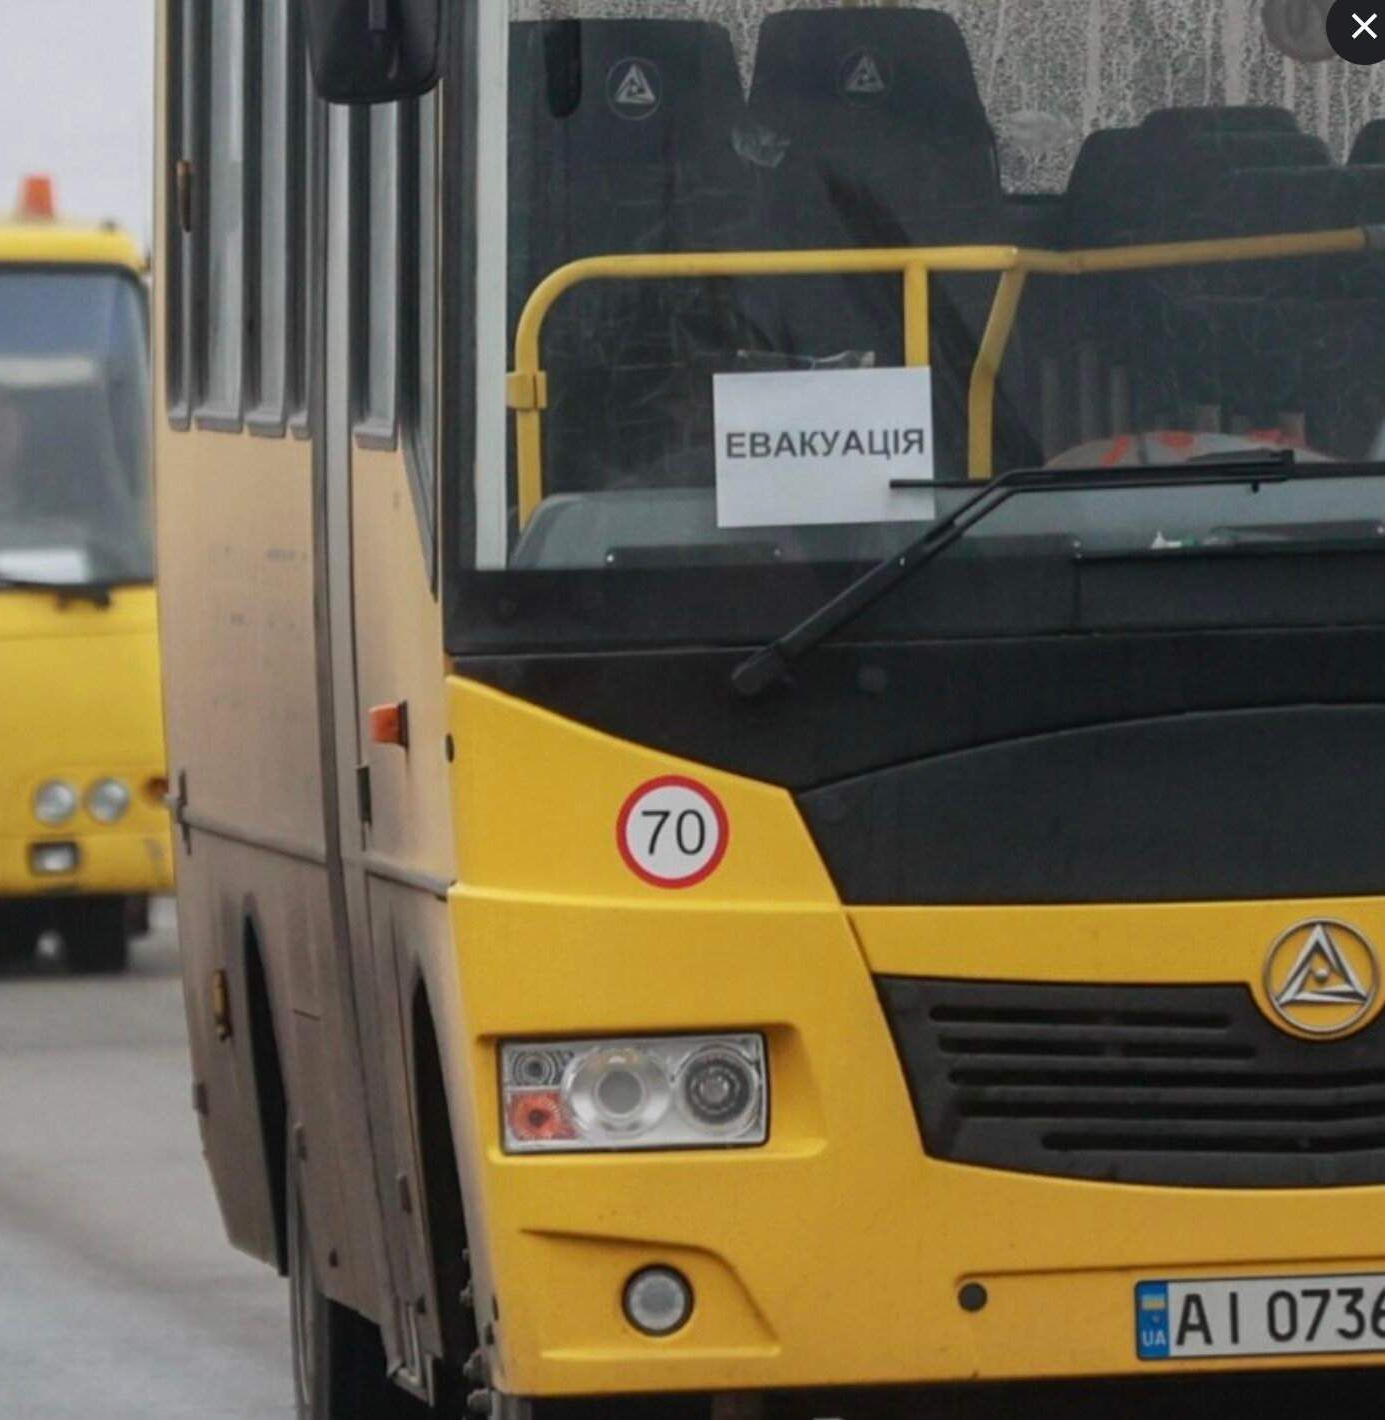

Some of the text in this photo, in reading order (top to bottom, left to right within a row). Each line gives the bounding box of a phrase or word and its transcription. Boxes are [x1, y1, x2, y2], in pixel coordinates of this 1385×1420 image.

[726, 428, 925, 460] ЕВАКУАЦІЯ
[642, 808, 706, 855] 70
[1142, 1330, 1167, 1347] UA
